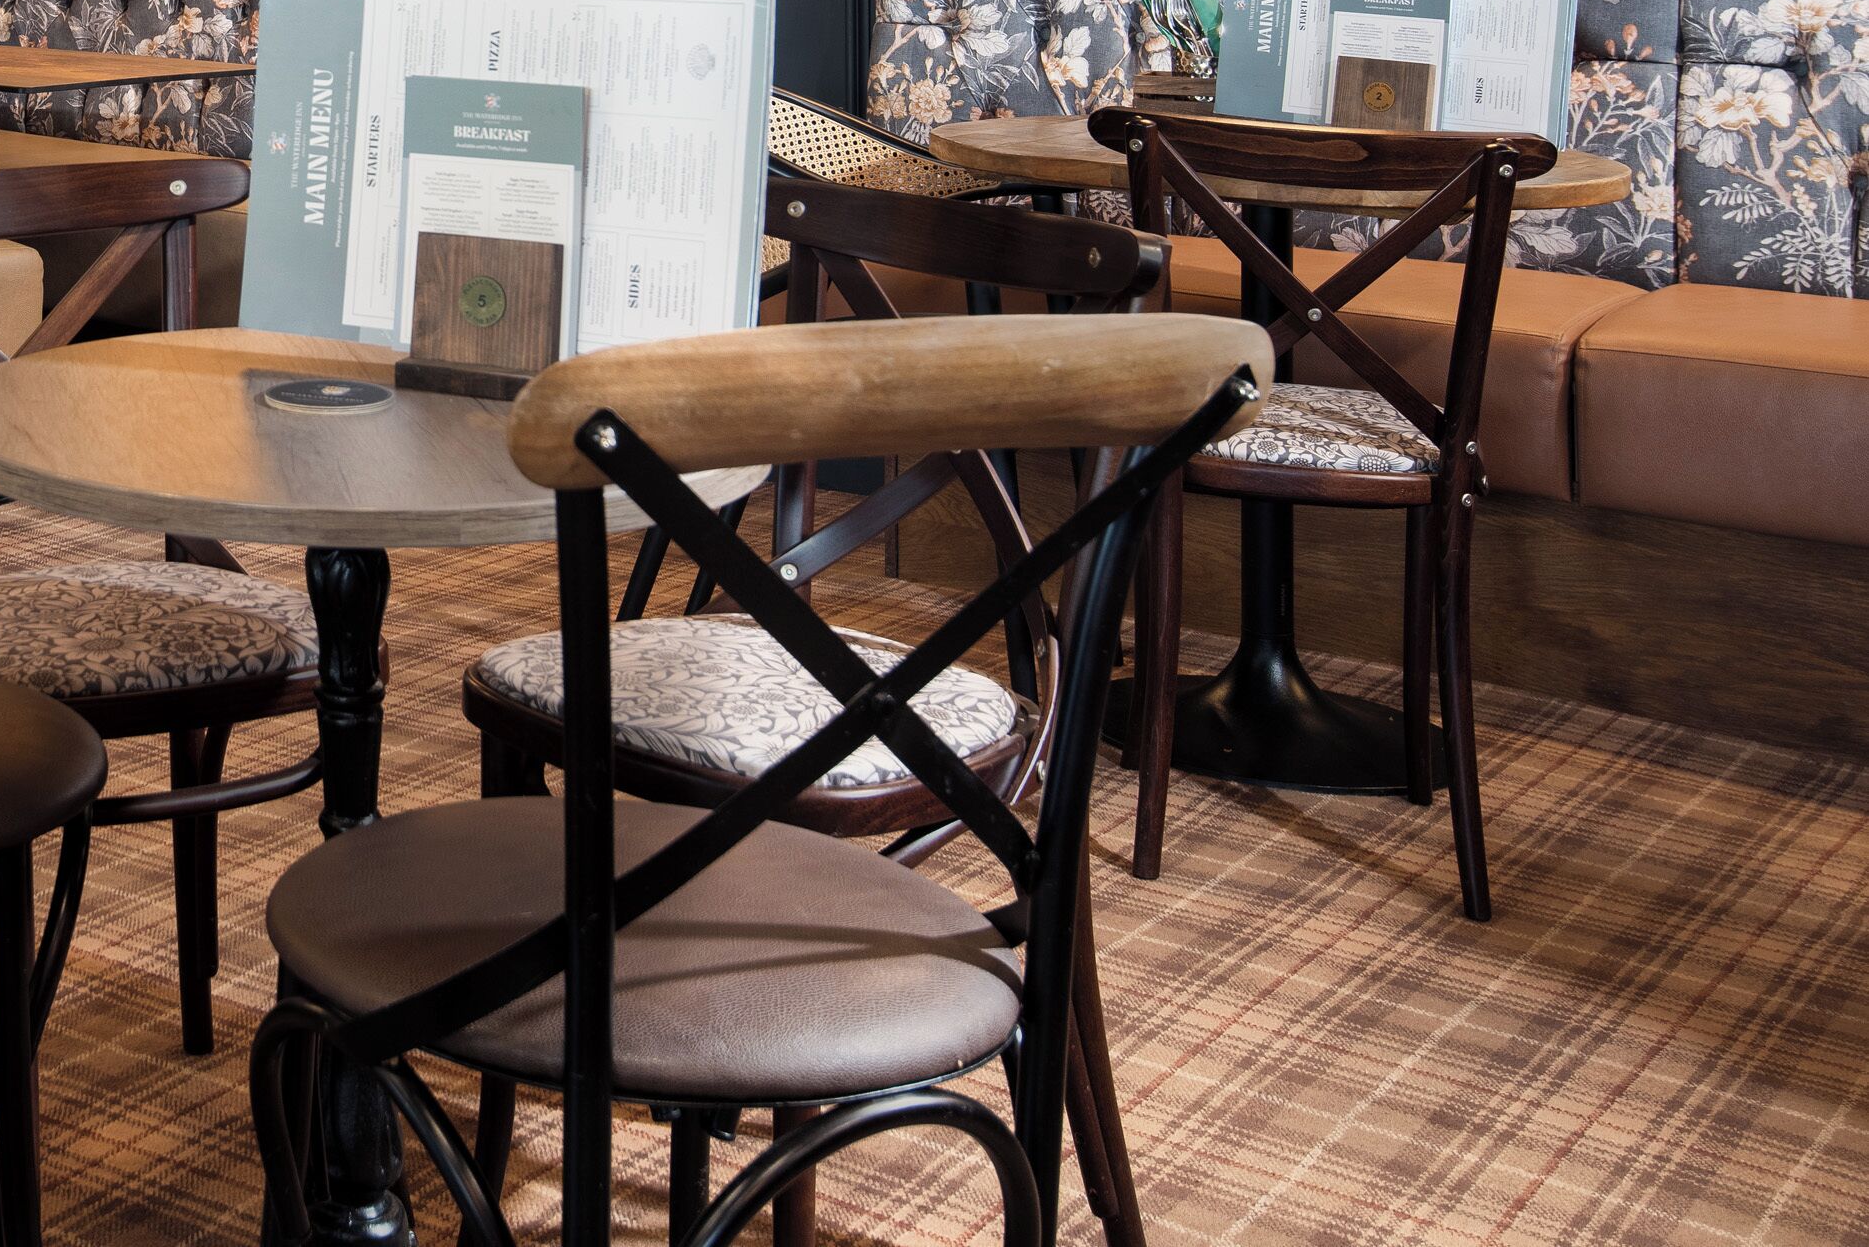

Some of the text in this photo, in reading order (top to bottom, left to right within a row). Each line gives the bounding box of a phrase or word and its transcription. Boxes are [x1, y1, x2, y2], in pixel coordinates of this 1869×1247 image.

[488, 30, 500, 71] PIZZA
[1257, 10, 1273, 53] MAIN
[1376, 92, 1382, 101] 2
[1474, 78, 1484, 104] SIDES
[304, 68, 333, 226] MAIN MENU
[366, 115, 380, 188] STARTERS
[453, 125, 531, 142] BREAKFAST
[477, 294, 486, 308] 5
[628, 264, 641, 309] SIDES
